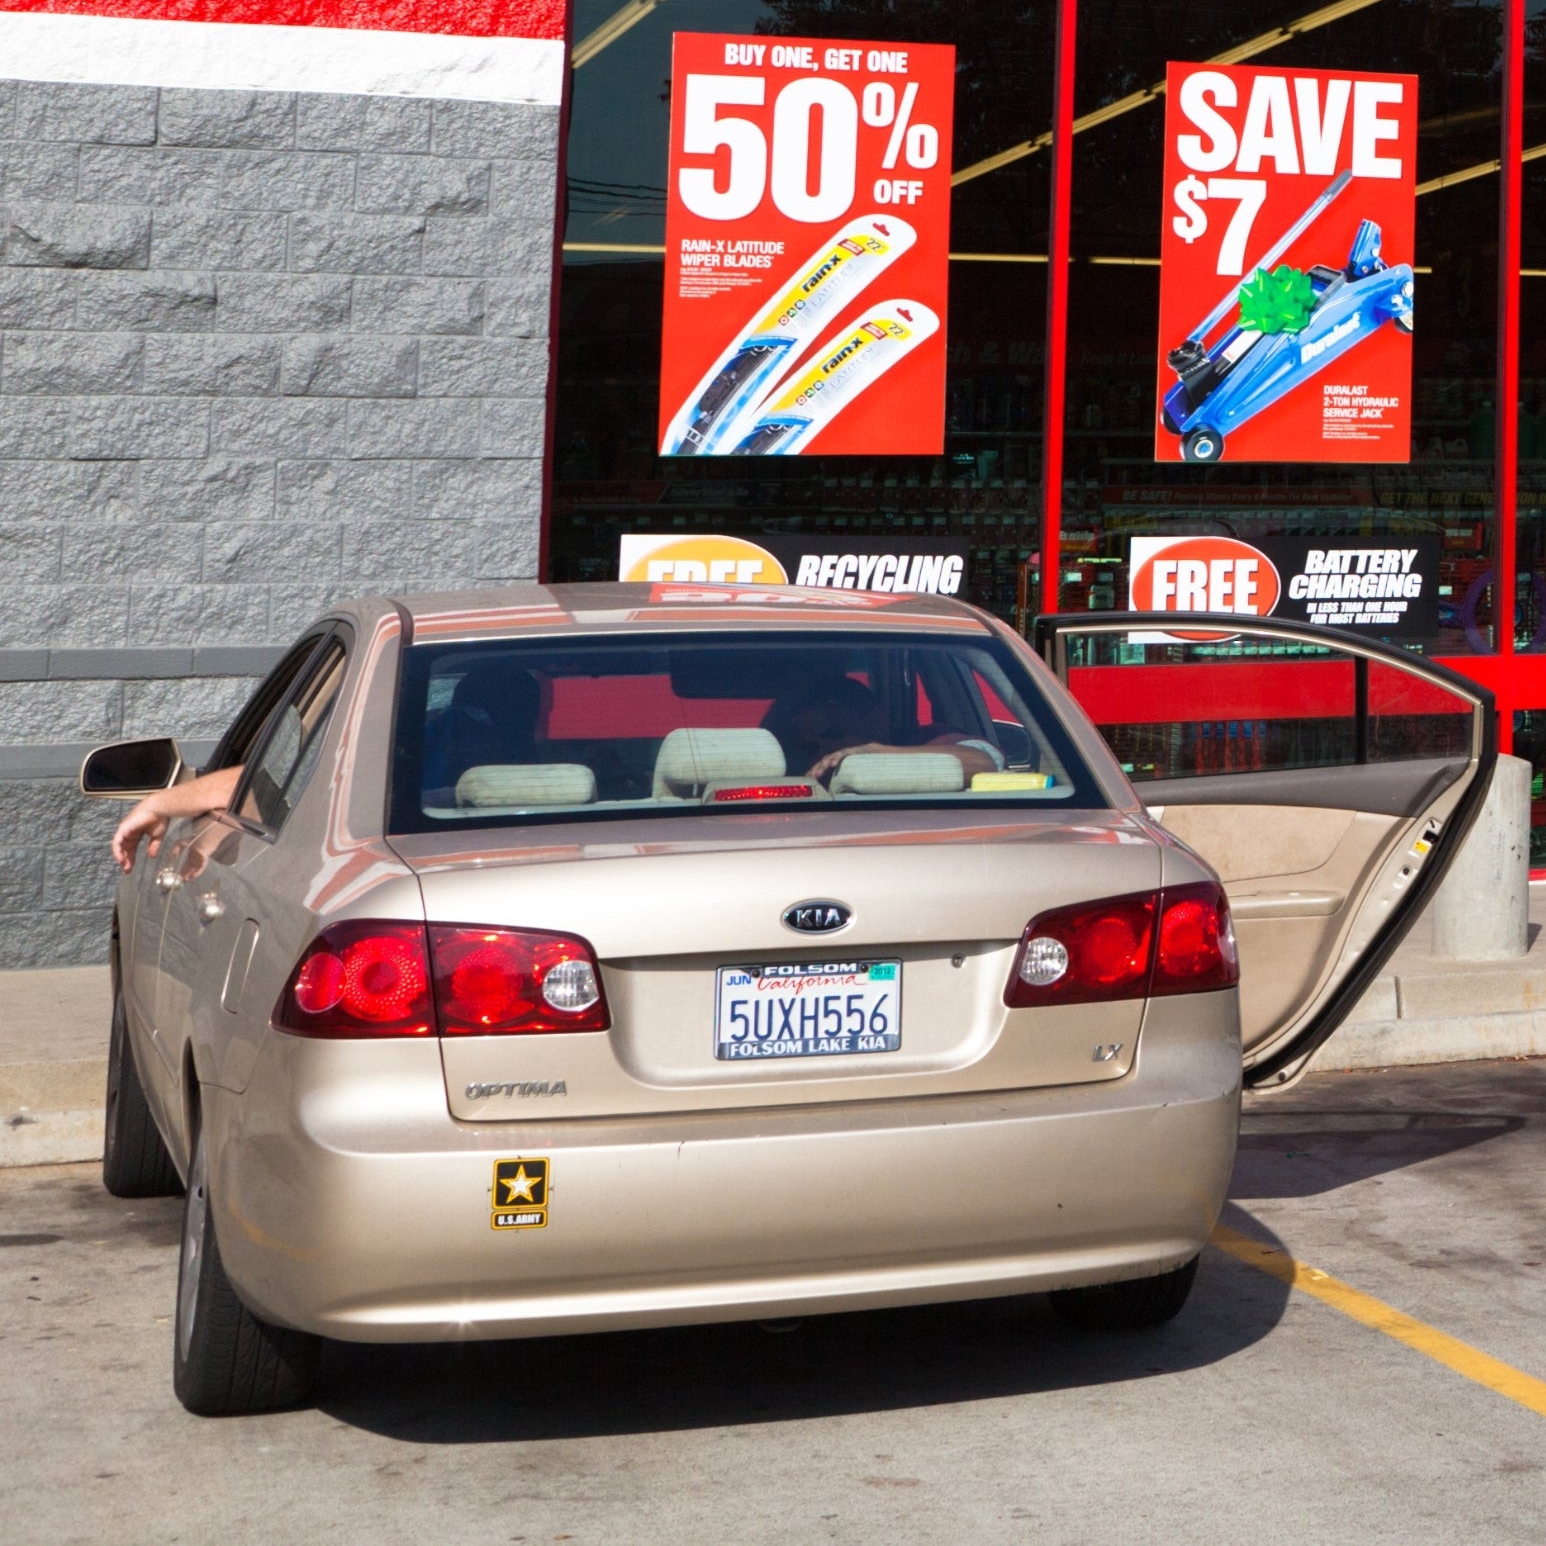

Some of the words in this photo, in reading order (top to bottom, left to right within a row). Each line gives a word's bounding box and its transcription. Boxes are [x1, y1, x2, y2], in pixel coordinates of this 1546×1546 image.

[725, 43, 766, 66] BUY
[771, 46, 819, 71] ONE,
[825, 49, 862, 70] GET
[867, 50, 908, 73] ONE
[1177, 70, 1404, 179] SAVE
[679, 73, 939, 223] 50%
[873, 179, 923, 204] OFF
[1172, 174, 1267, 276] $7
[681, 239, 725, 252] RAIN-X
[727, 240, 784, 254] LATITUDE
[681, 253, 720, 266] WIPER
[1324, 385, 1368, 395] DURALAST
[1323, 396, 1350, 406] 2-TON
[1351, 397, 1399, 408] HYDRAULIC
[1323, 408, 1358, 418] SERVICE
[796, 555, 964, 595] RECYCLING
[1152, 559, 1258, 615] FREE
[1304, 549, 1418, 574] BATTERY
[1289, 573, 1422, 600] CHARGING
[1319, 602, 1339, 613] LESS
[1340, 602, 1363, 613] THAN
[1365, 601, 1382, 612] ONE
[1383, 601, 1407, 612] HOUR
[1309, 613, 1328, 624] FOR
[1328, 613, 1354, 624] MOST
[1355, 612, 1399, 623] BATTERIES
[796, 908, 841, 927] KIA
[764, 963, 857, 976] FOLSOM
[726, 975, 752, 986] JUN
[757, 974, 867, 995] California
[730, 994, 888, 1042] 5UXH556
[730, 1040, 802, 1056] FOLSOM
[809, 1038, 850, 1052] LAKE
[858, 1035, 886, 1050] KIA
[465, 1080, 568, 1100] OPTIMA
